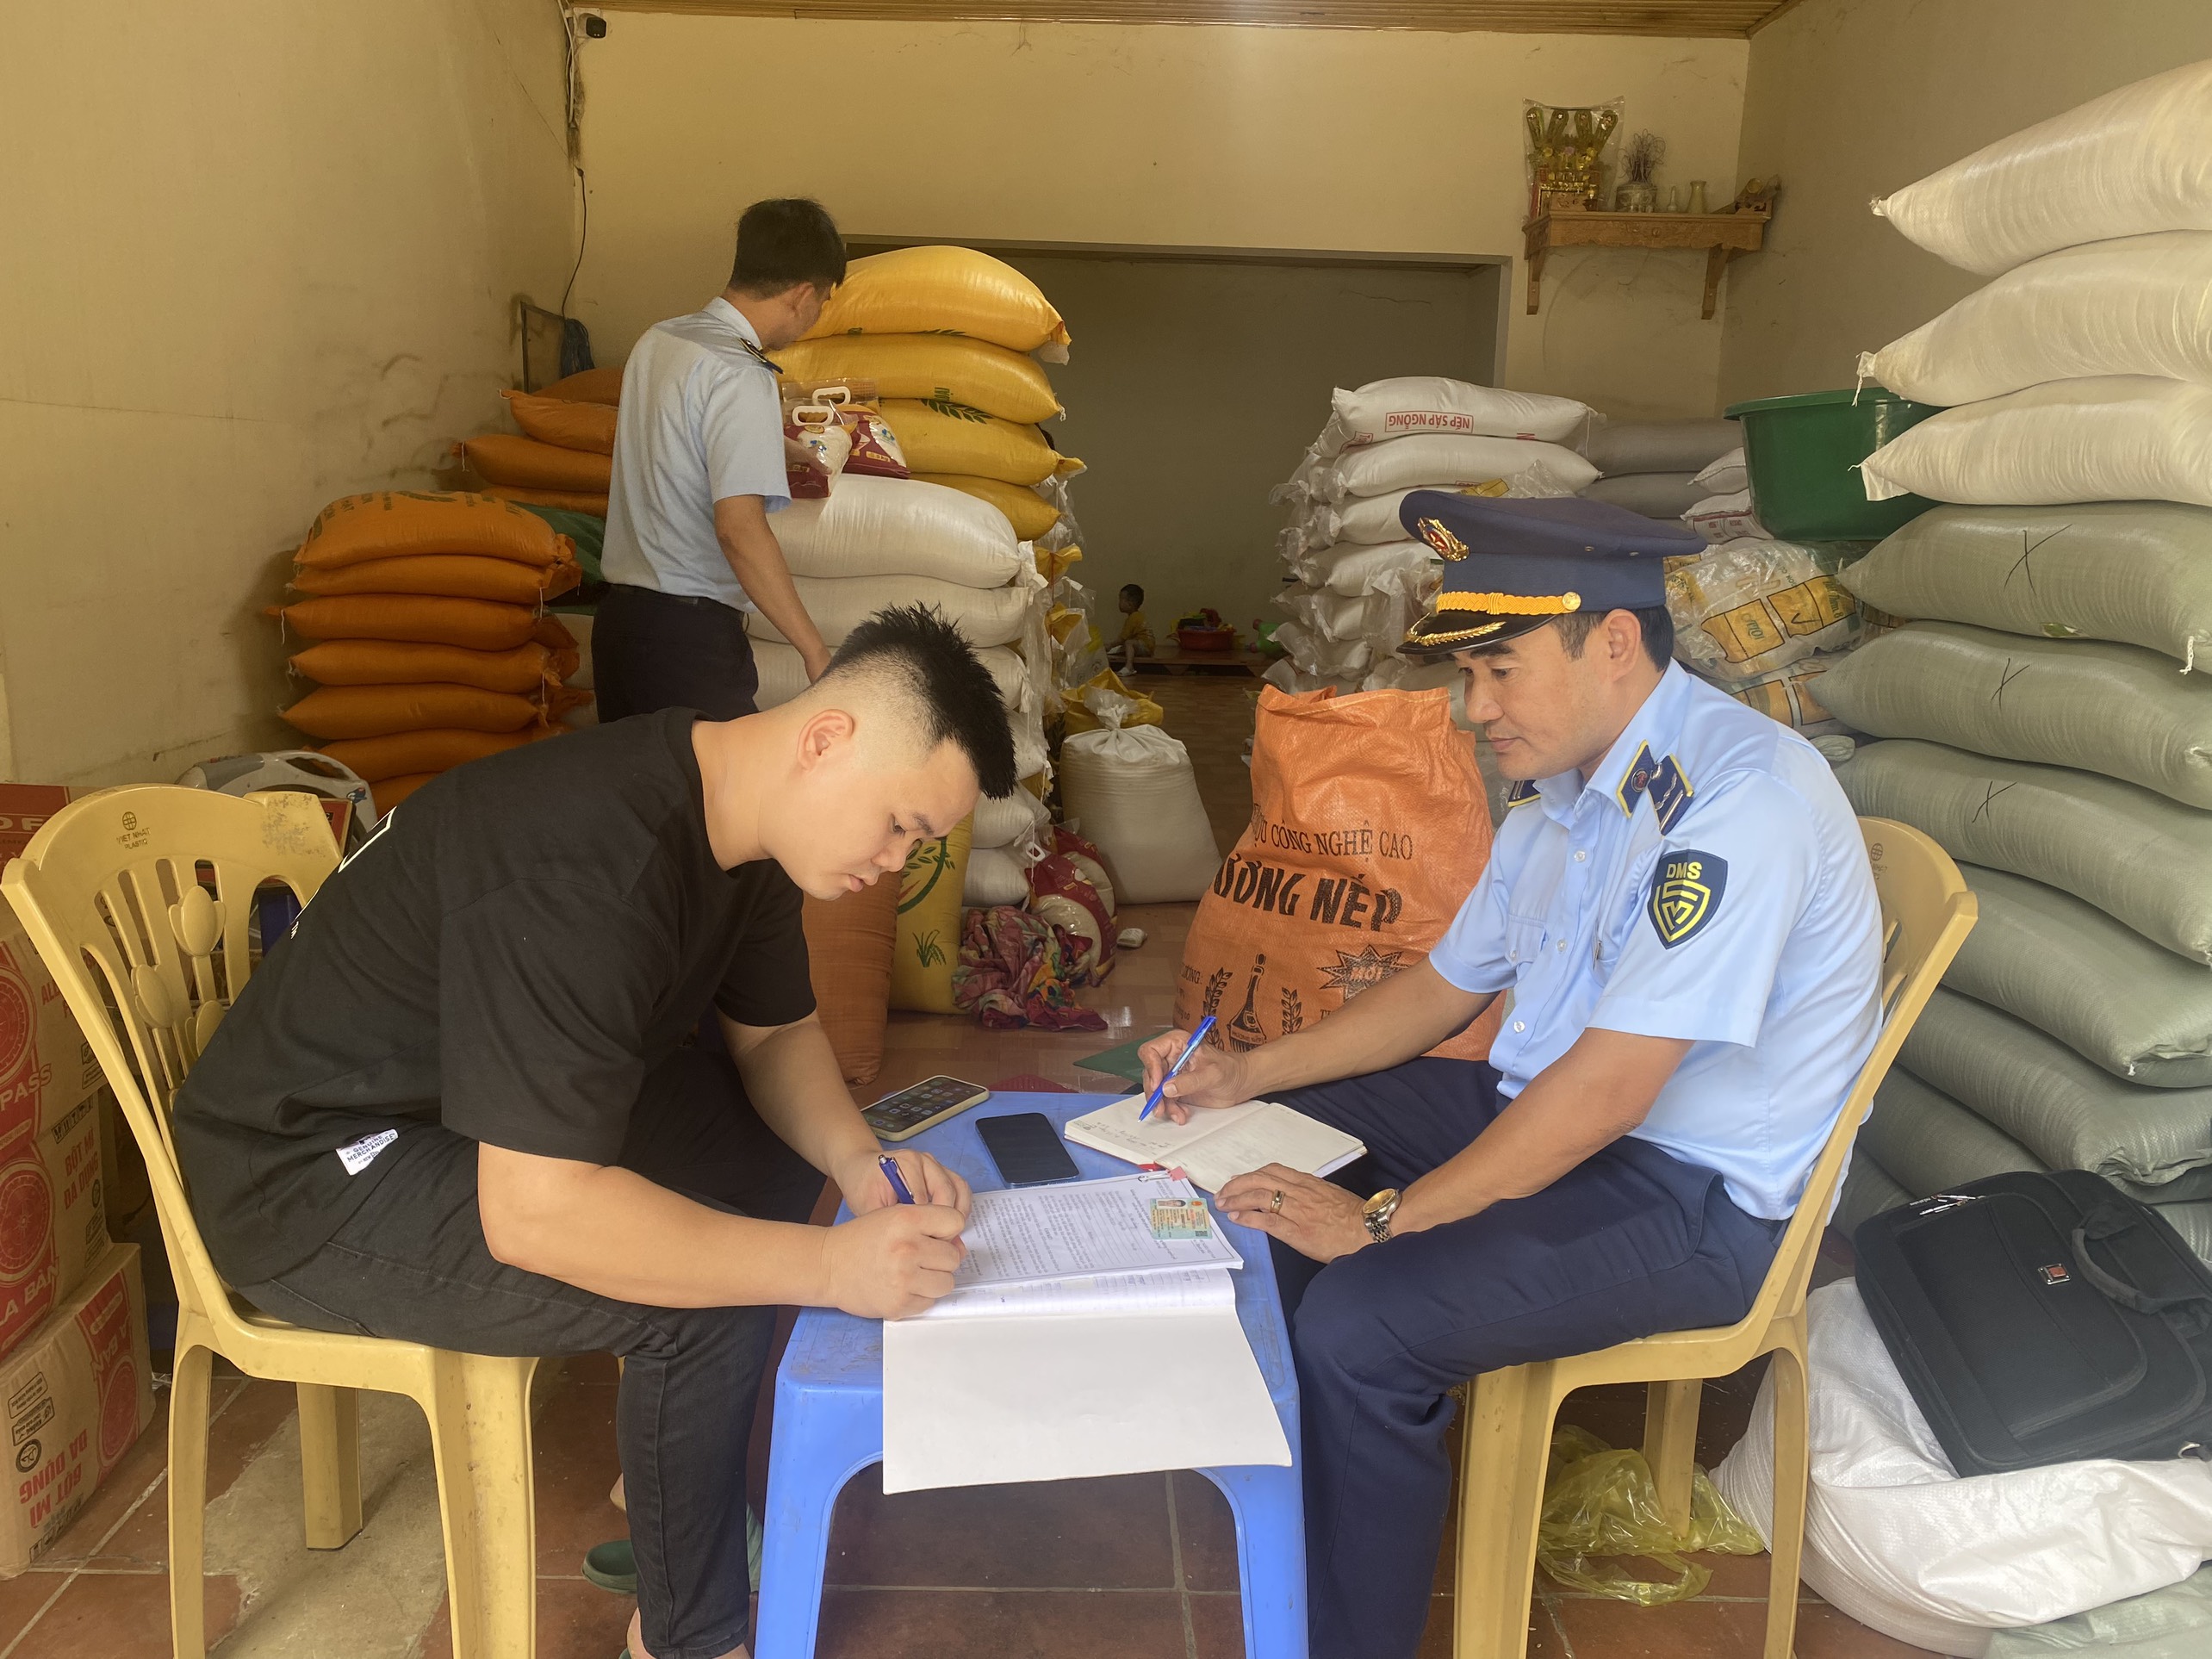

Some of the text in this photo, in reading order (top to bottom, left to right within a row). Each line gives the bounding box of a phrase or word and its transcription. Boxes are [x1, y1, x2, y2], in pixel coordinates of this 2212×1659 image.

[1389, 413, 1470, 431] NẾP SÁP NGỖNG
[1271, 819, 1312, 854] CÔNG
[1314, 820, 1373, 863] NGHỆ
[1379, 830, 1414, 861] CAO
[1666, 861, 1703, 879] DMS
[1309, 873, 1403, 933] NẾP
